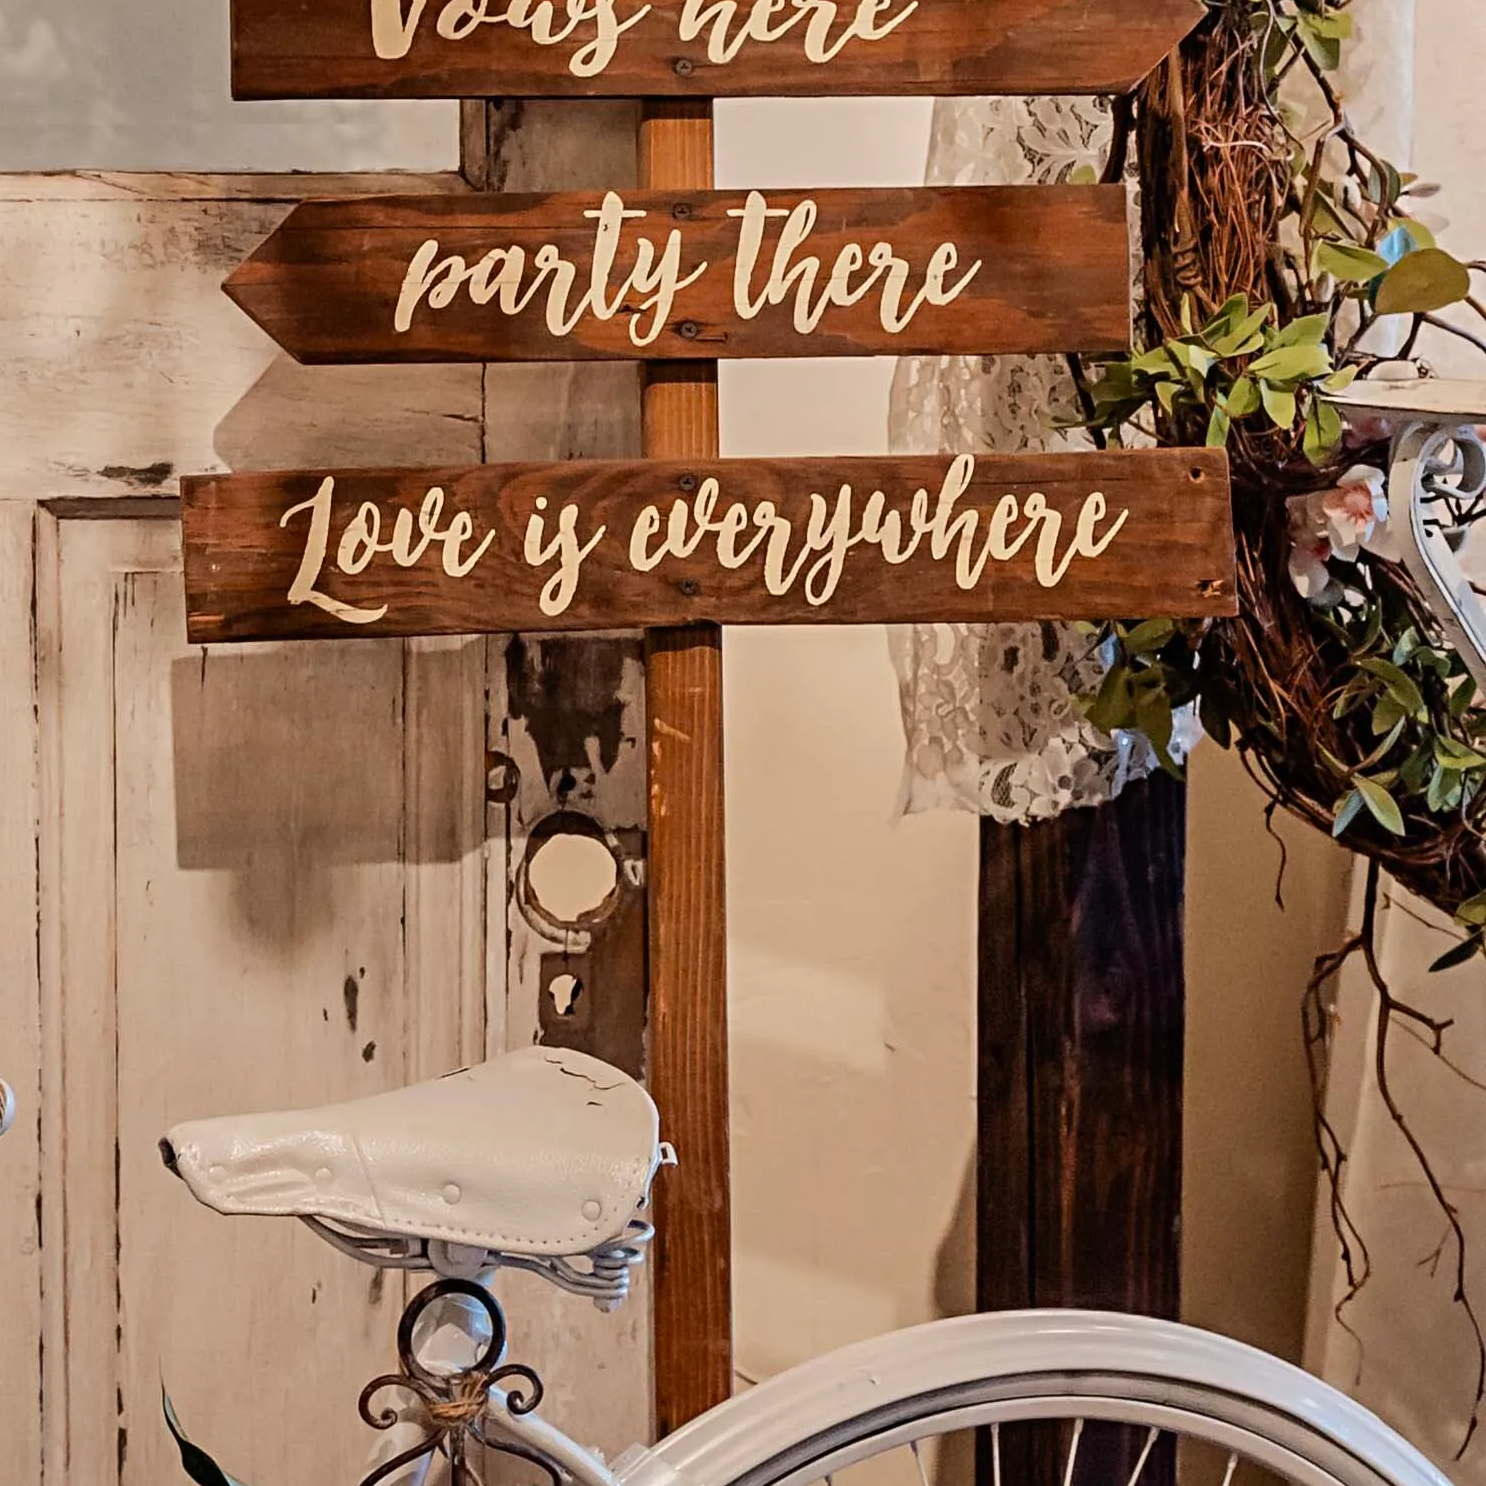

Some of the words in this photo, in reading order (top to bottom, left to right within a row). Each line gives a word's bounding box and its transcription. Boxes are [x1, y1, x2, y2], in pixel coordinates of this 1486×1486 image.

[394, 191, 708, 346] party
[727, 190, 981, 333] there
[280, 476, 495, 623] Love
[524, 496, 605, 616] is
[629, 454, 1129, 605] everywhere
